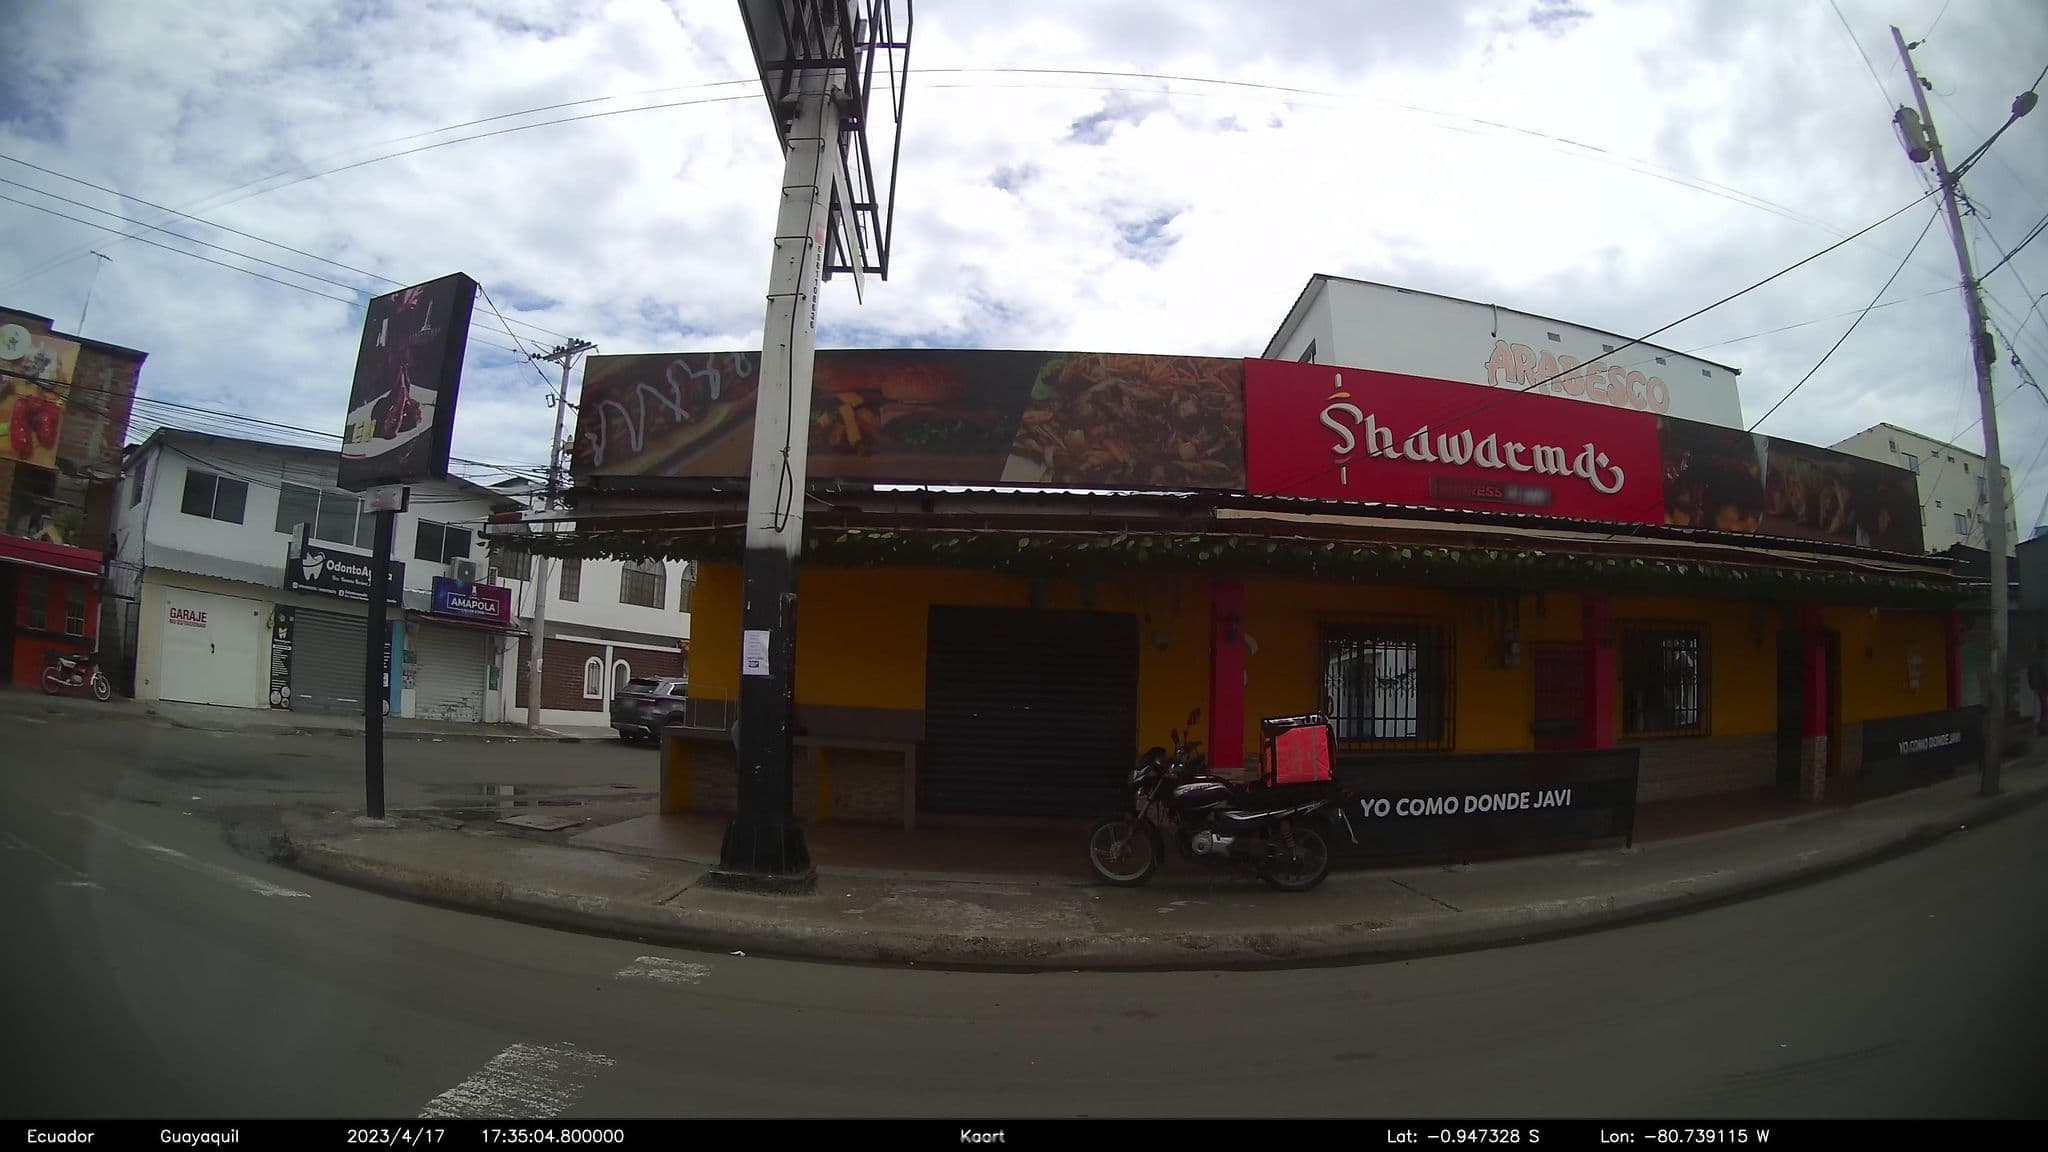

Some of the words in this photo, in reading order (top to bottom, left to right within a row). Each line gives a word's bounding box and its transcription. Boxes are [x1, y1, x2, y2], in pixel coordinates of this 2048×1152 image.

[1485, 340, 1671, 414] ARABESCO
[169, 607, 208, 623] GARAJE
[450, 597, 496, 612] AMAPOLA
[1360, 798, 1391, 818] YO
[1396, 796, 1459, 816] COMO
[1464, 791, 1530, 814] DONDE
[1533, 788, 1572, 809] JAVI
